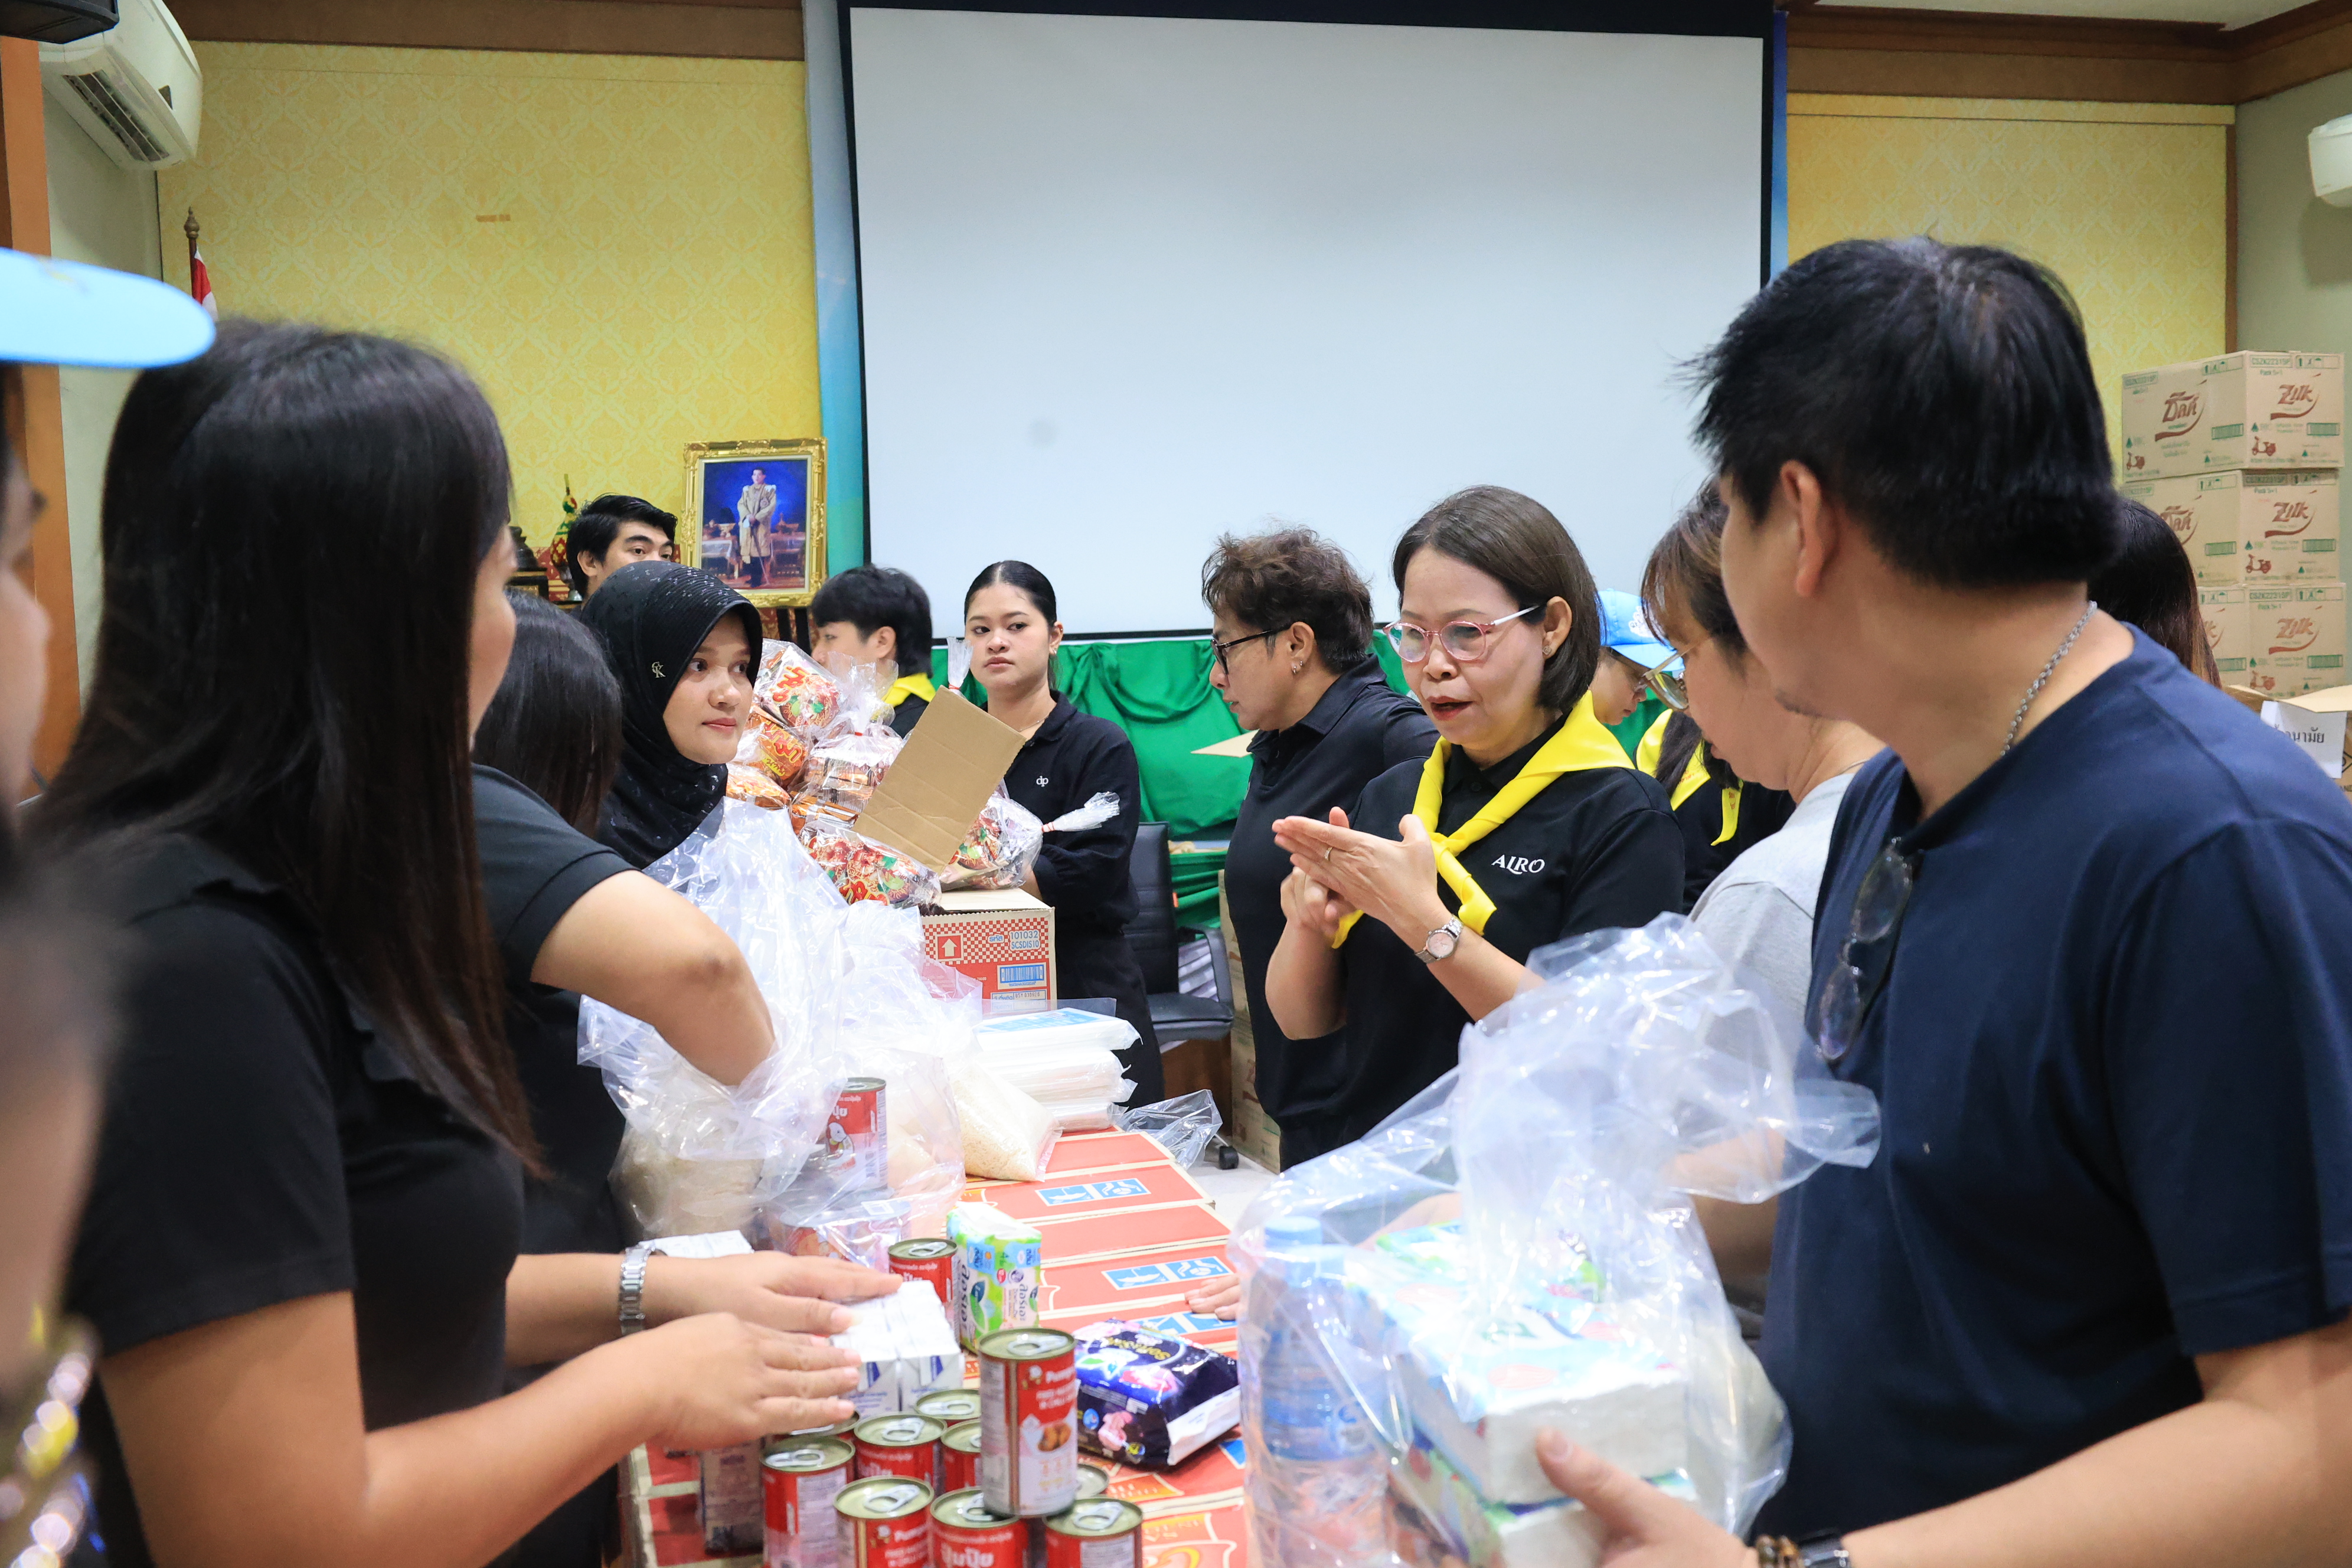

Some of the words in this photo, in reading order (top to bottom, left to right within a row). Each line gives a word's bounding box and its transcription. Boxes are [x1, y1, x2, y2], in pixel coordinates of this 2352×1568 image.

[2278, 384, 2313, 405] Zilk
[2272, 502, 2309, 522] Zilk
[2276, 618, 2314, 638] Zilk
[1491, 854, 1545, 875] ALRO
[989, 934, 1003, 942] รหัส
[1010, 930, 1038, 940] 101032
[1011, 940, 1039, 949] SCSDIS10
